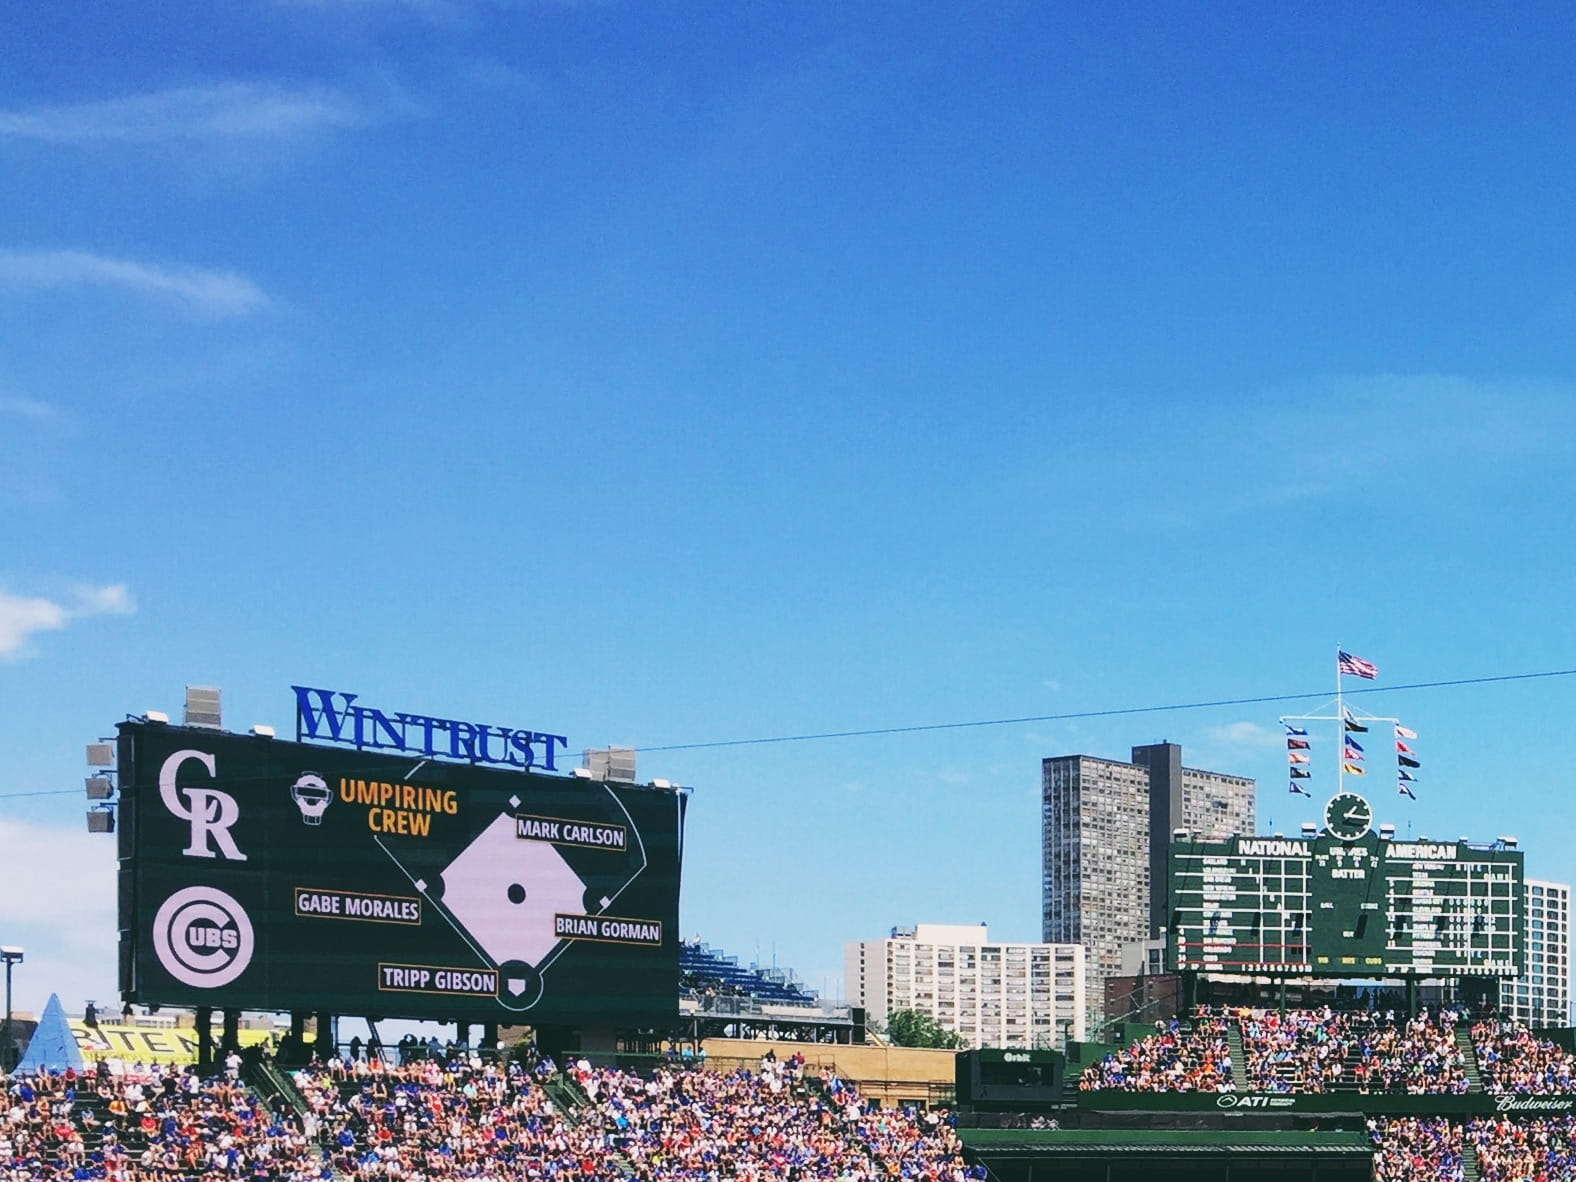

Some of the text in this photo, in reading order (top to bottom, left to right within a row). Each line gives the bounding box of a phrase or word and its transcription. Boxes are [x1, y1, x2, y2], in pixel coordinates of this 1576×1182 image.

[291, 685, 567, 771] WINTRUST
[340, 777, 458, 814] UMPIRING
[368, 806, 431, 837] CREW
[517, 818, 625, 847] MARK CARLSON
[1238, 840, 1311, 856] NATIONAL
[1385, 844, 1457, 859] AMERICAN
[1332, 869, 1365, 879] BATTER
[298, 893, 419, 922] GABE MORALES
[556, 917, 660, 942] BRIAN GORMAN
[383, 967, 496, 993] TRIPP GIBSON
[1237, 1096, 1269, 1107] ATI
[1494, 1095, 1573, 1111] Budweiser
